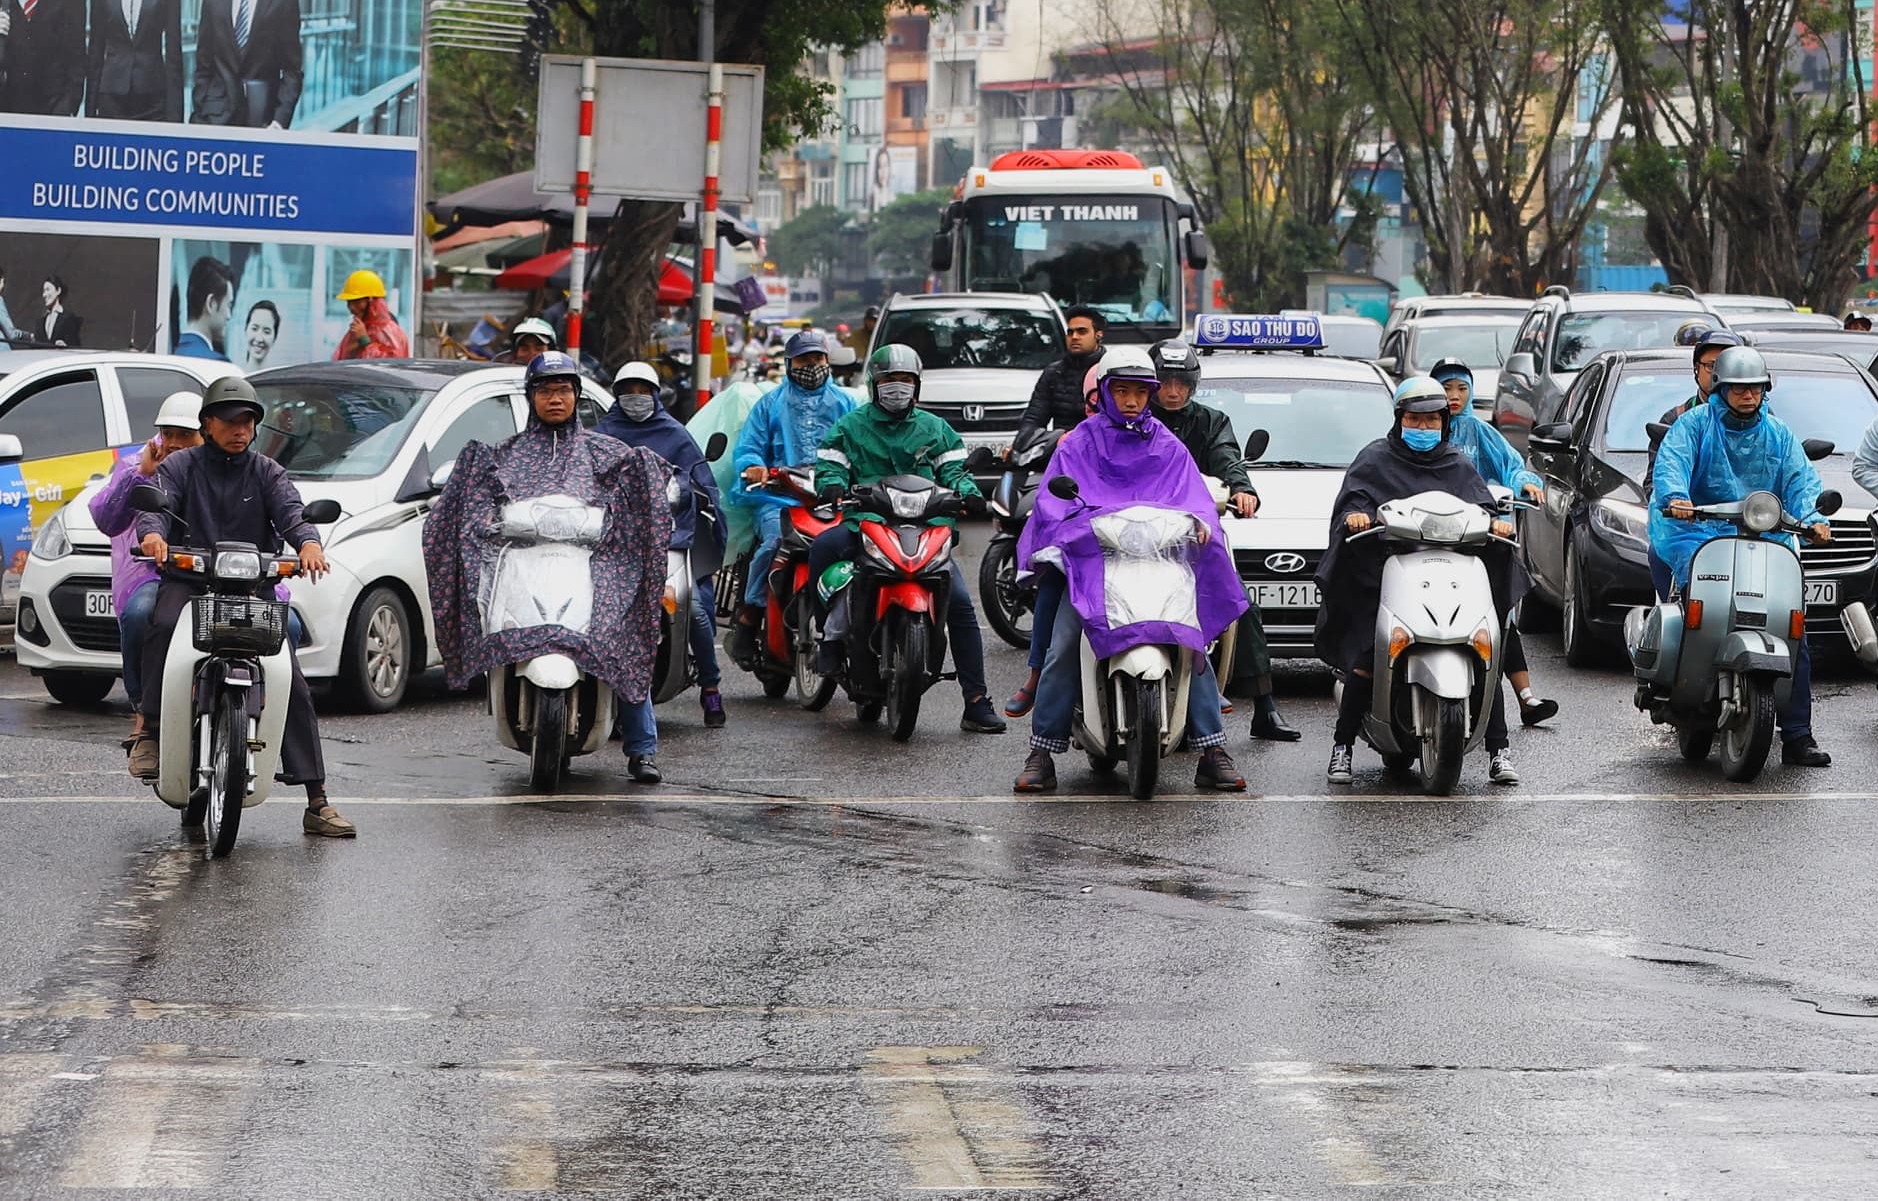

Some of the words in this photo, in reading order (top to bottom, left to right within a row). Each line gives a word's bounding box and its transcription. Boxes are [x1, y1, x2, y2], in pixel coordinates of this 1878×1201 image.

[73, 144, 179, 174] BUILDING
[185, 150, 265, 178] PEOPLE
[33, 182, 139, 211] BUILDING
[145, 188, 299, 219] COMMUNITIES
[1005, 205, 1055, 222] VIET
[1061, 205, 1139, 221] THANH
[1232, 320, 1261, 337] SAO
